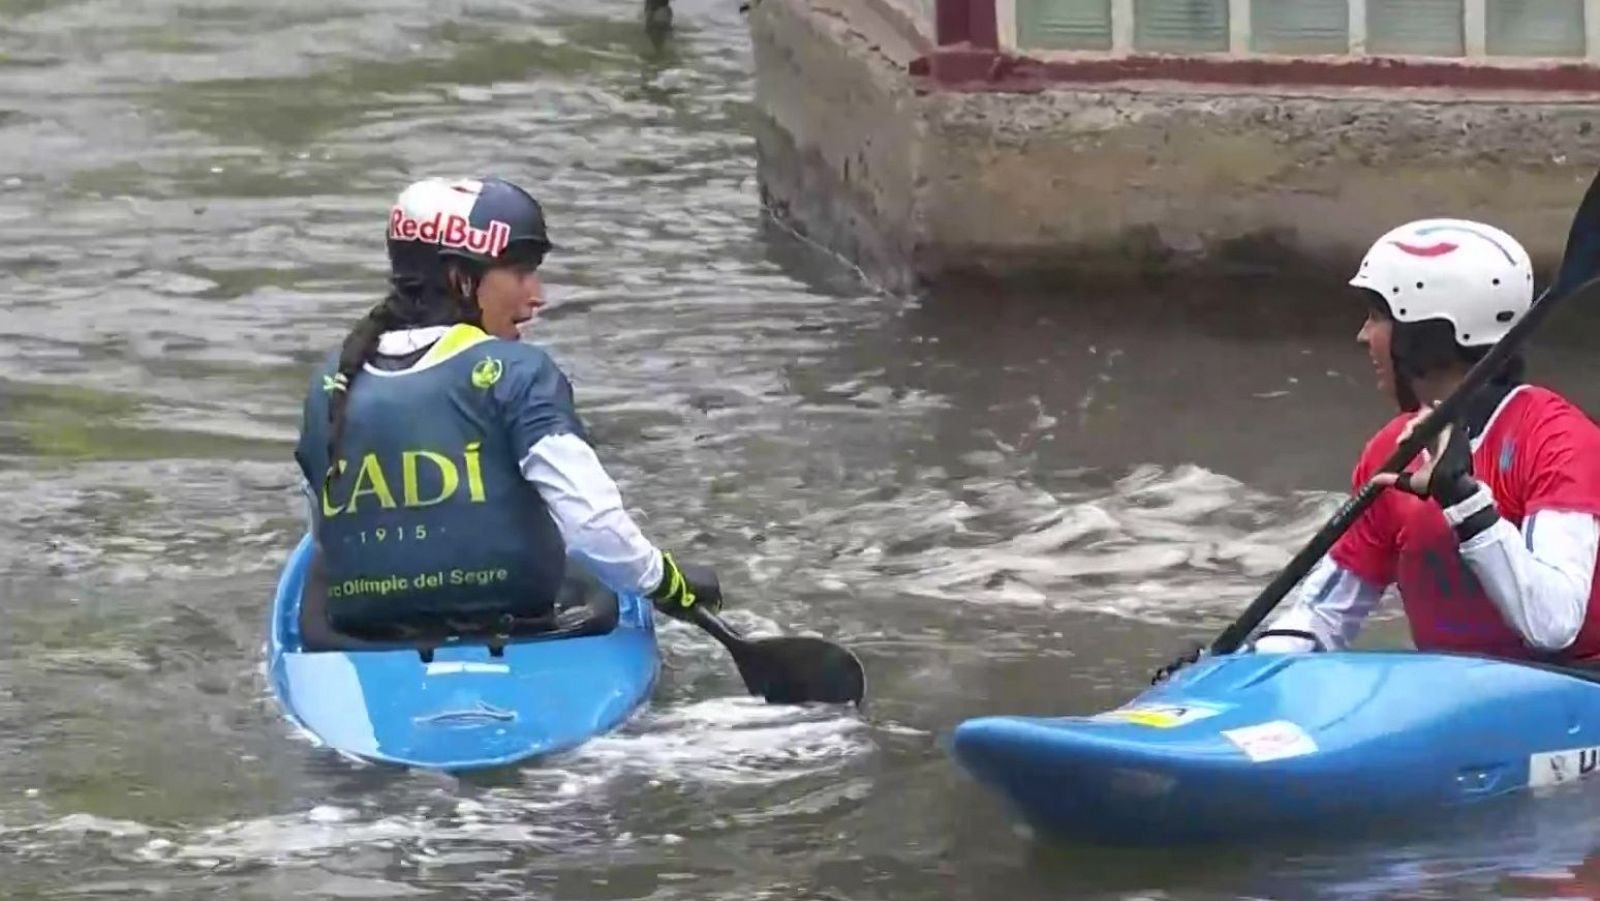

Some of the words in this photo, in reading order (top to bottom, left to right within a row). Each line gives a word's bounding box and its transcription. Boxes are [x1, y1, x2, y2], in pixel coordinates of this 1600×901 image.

[390, 208, 443, 242] Red
[444, 214, 508, 257] Bull
[322, 442, 487, 518] CADÍ
[359, 524, 428, 544] 1915
[413, 572, 444, 589] del
[450, 568, 508, 586] Segre
[1579, 749, 1600, 774] U
